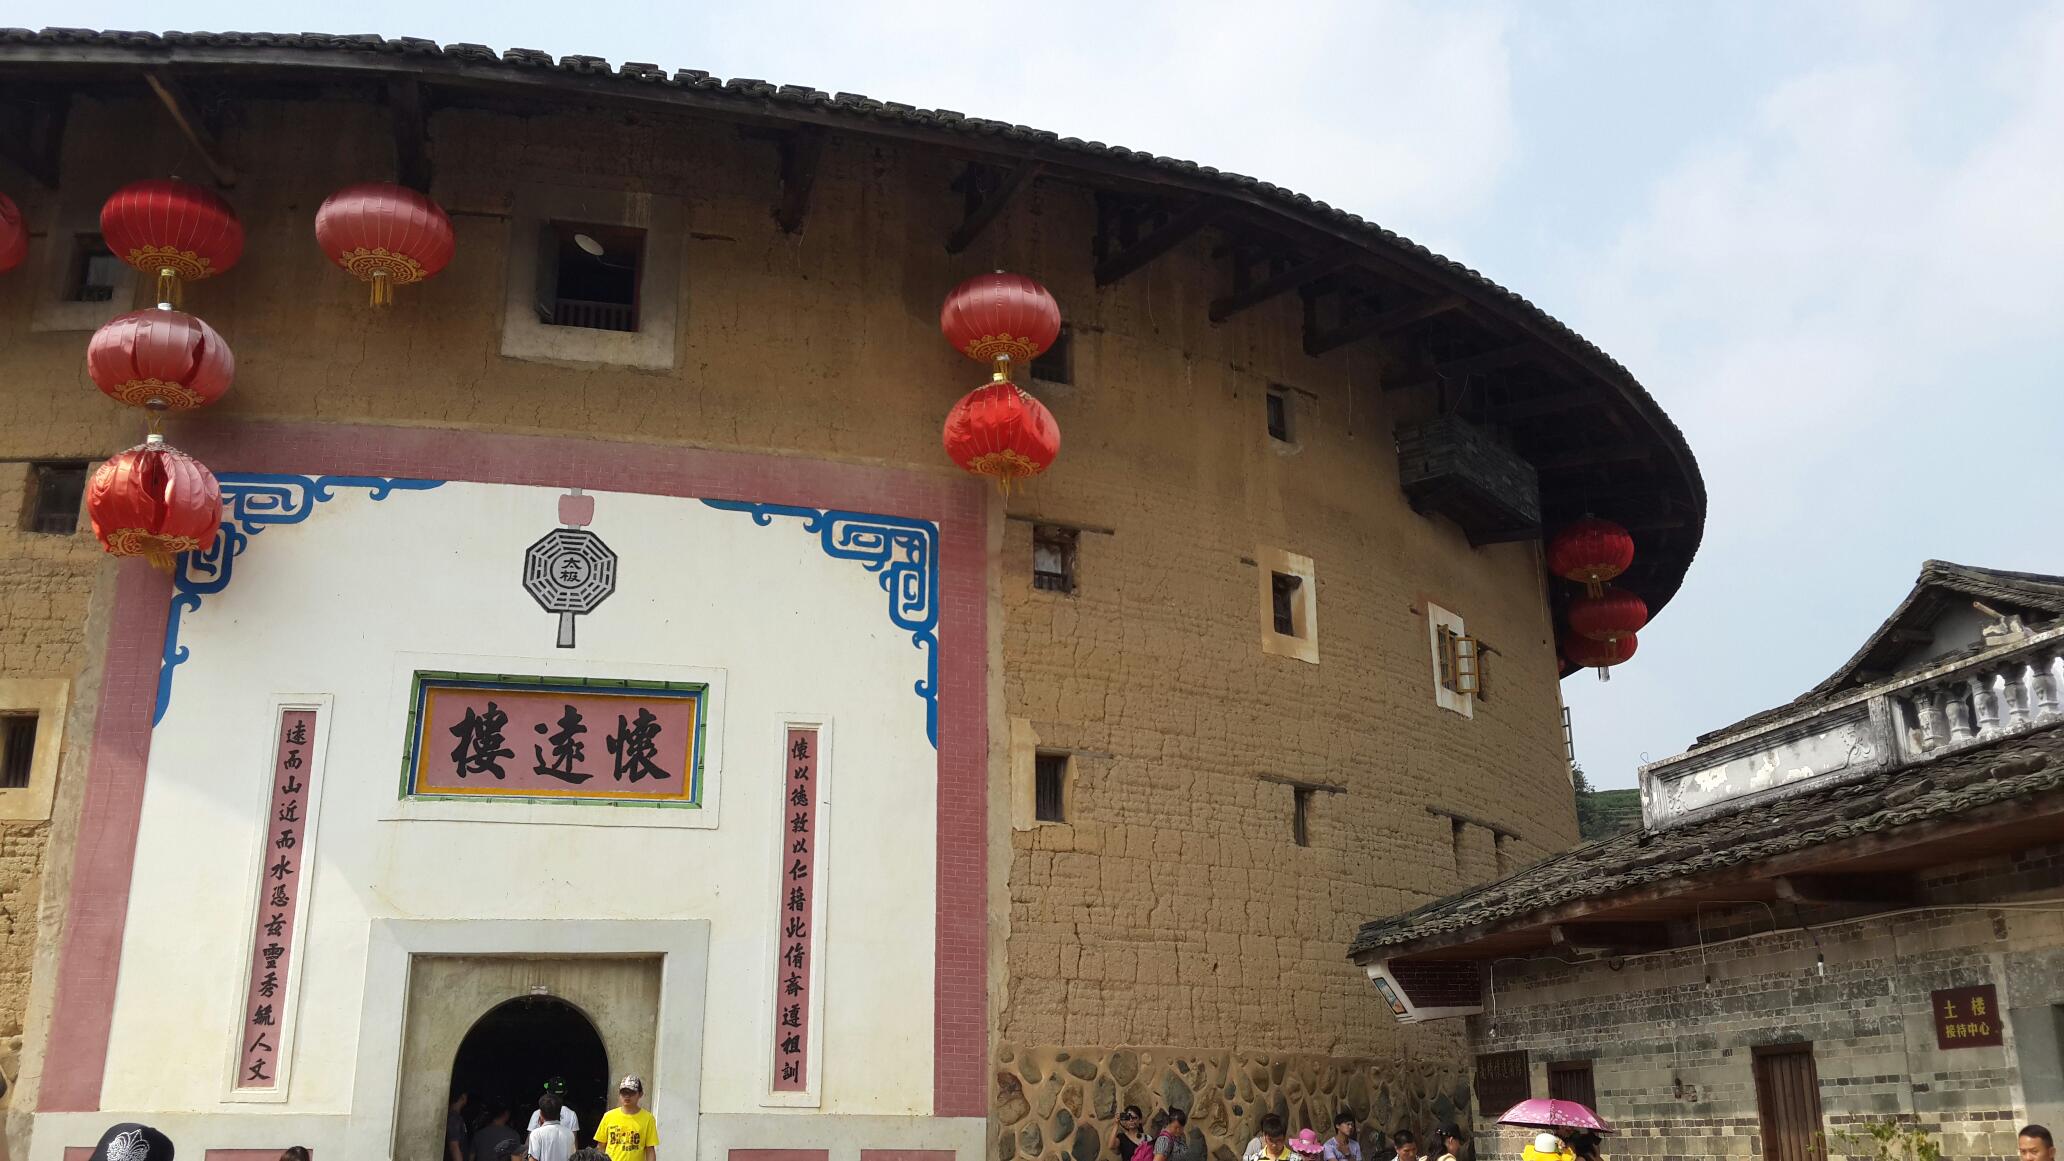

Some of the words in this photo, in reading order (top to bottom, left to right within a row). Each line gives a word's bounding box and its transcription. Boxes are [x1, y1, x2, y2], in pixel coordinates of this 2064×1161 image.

[559, 557, 583, 583] 太极
[1943, 996, 1986, 1019] 土楼
[1945, 1021, 1990, 1039] 接待中心
